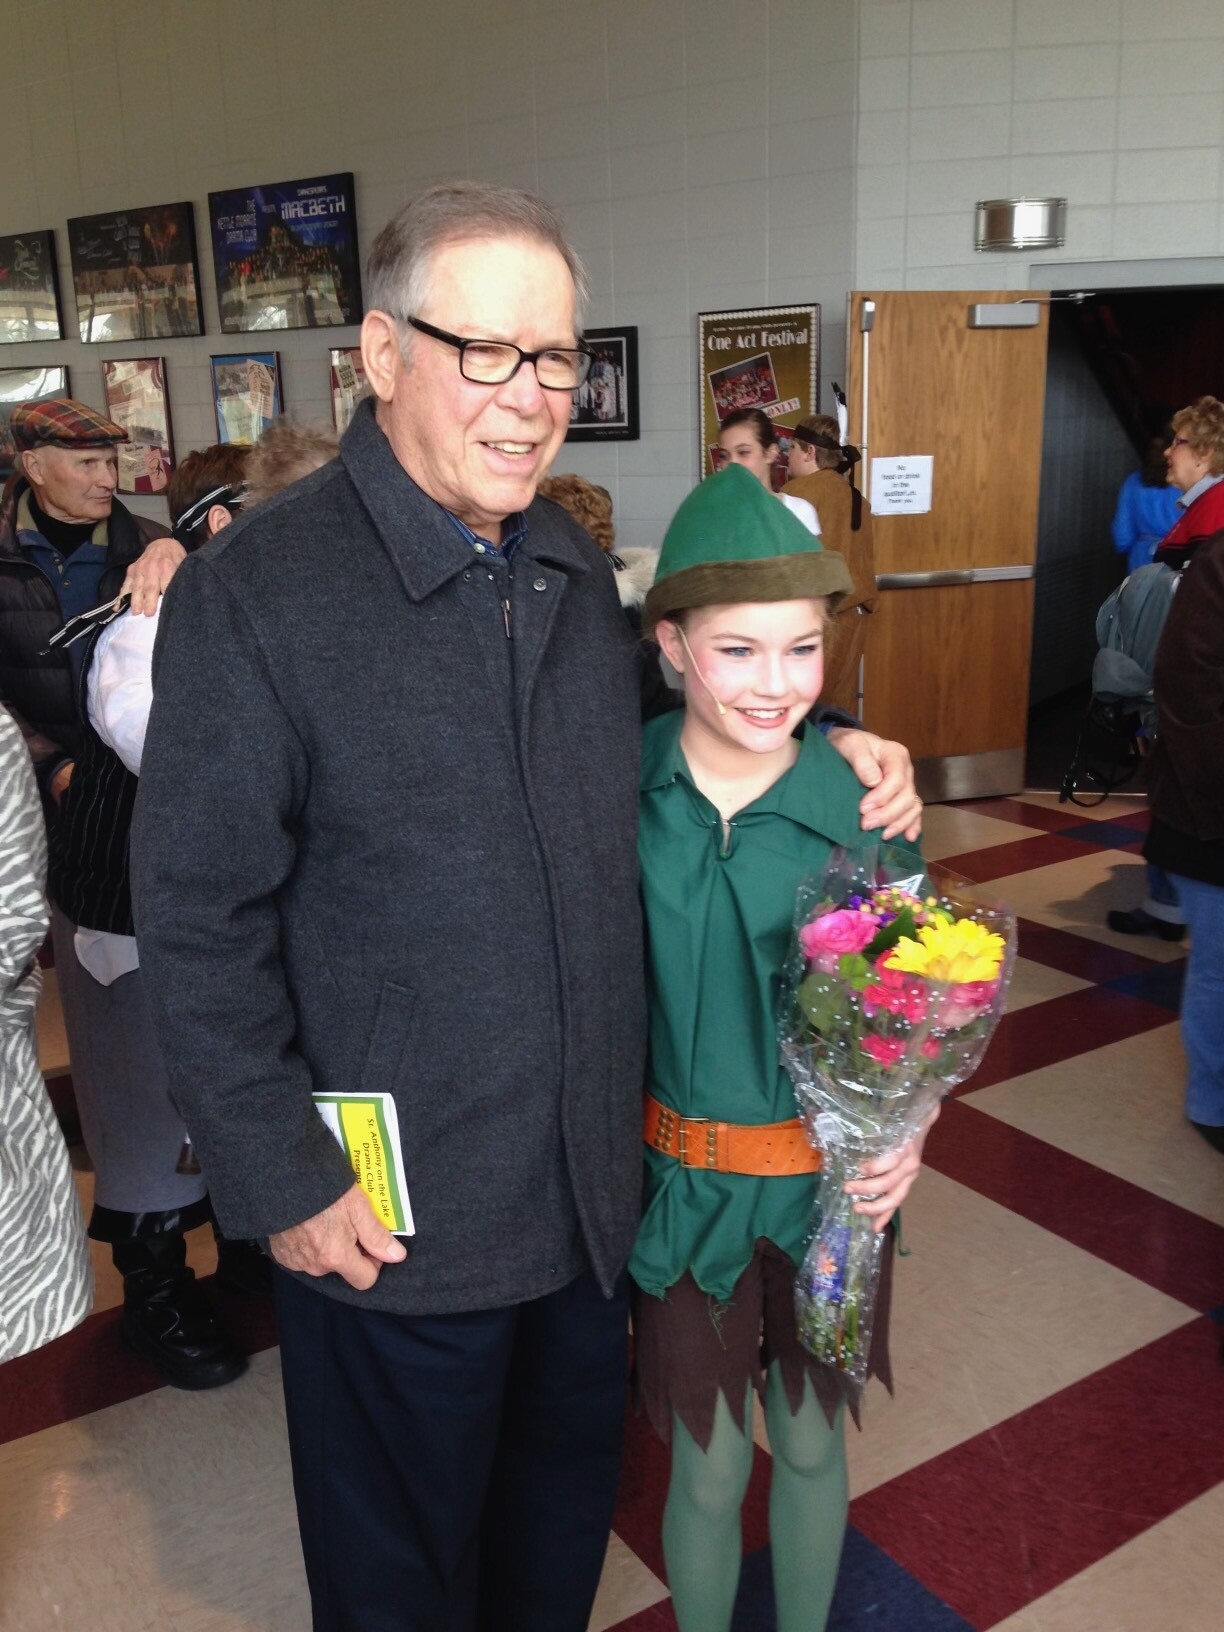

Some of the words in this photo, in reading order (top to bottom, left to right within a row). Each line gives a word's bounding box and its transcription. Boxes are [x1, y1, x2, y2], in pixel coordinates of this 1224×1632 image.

[280, 194, 346, 220] MACBETH
[707, 334, 732, 351] One
[736, 332, 756, 349] Act
[760, 328, 808, 347] Festival
[363, 1142, 371, 1169] Drama
[371, 1132, 381, 1168] Anthony
[366, 1173, 374, 1193] Club
[376, 1169, 383, 1181] on
[378, 1183, 386, 1197] the
[380, 1199, 390, 1218] Lake
